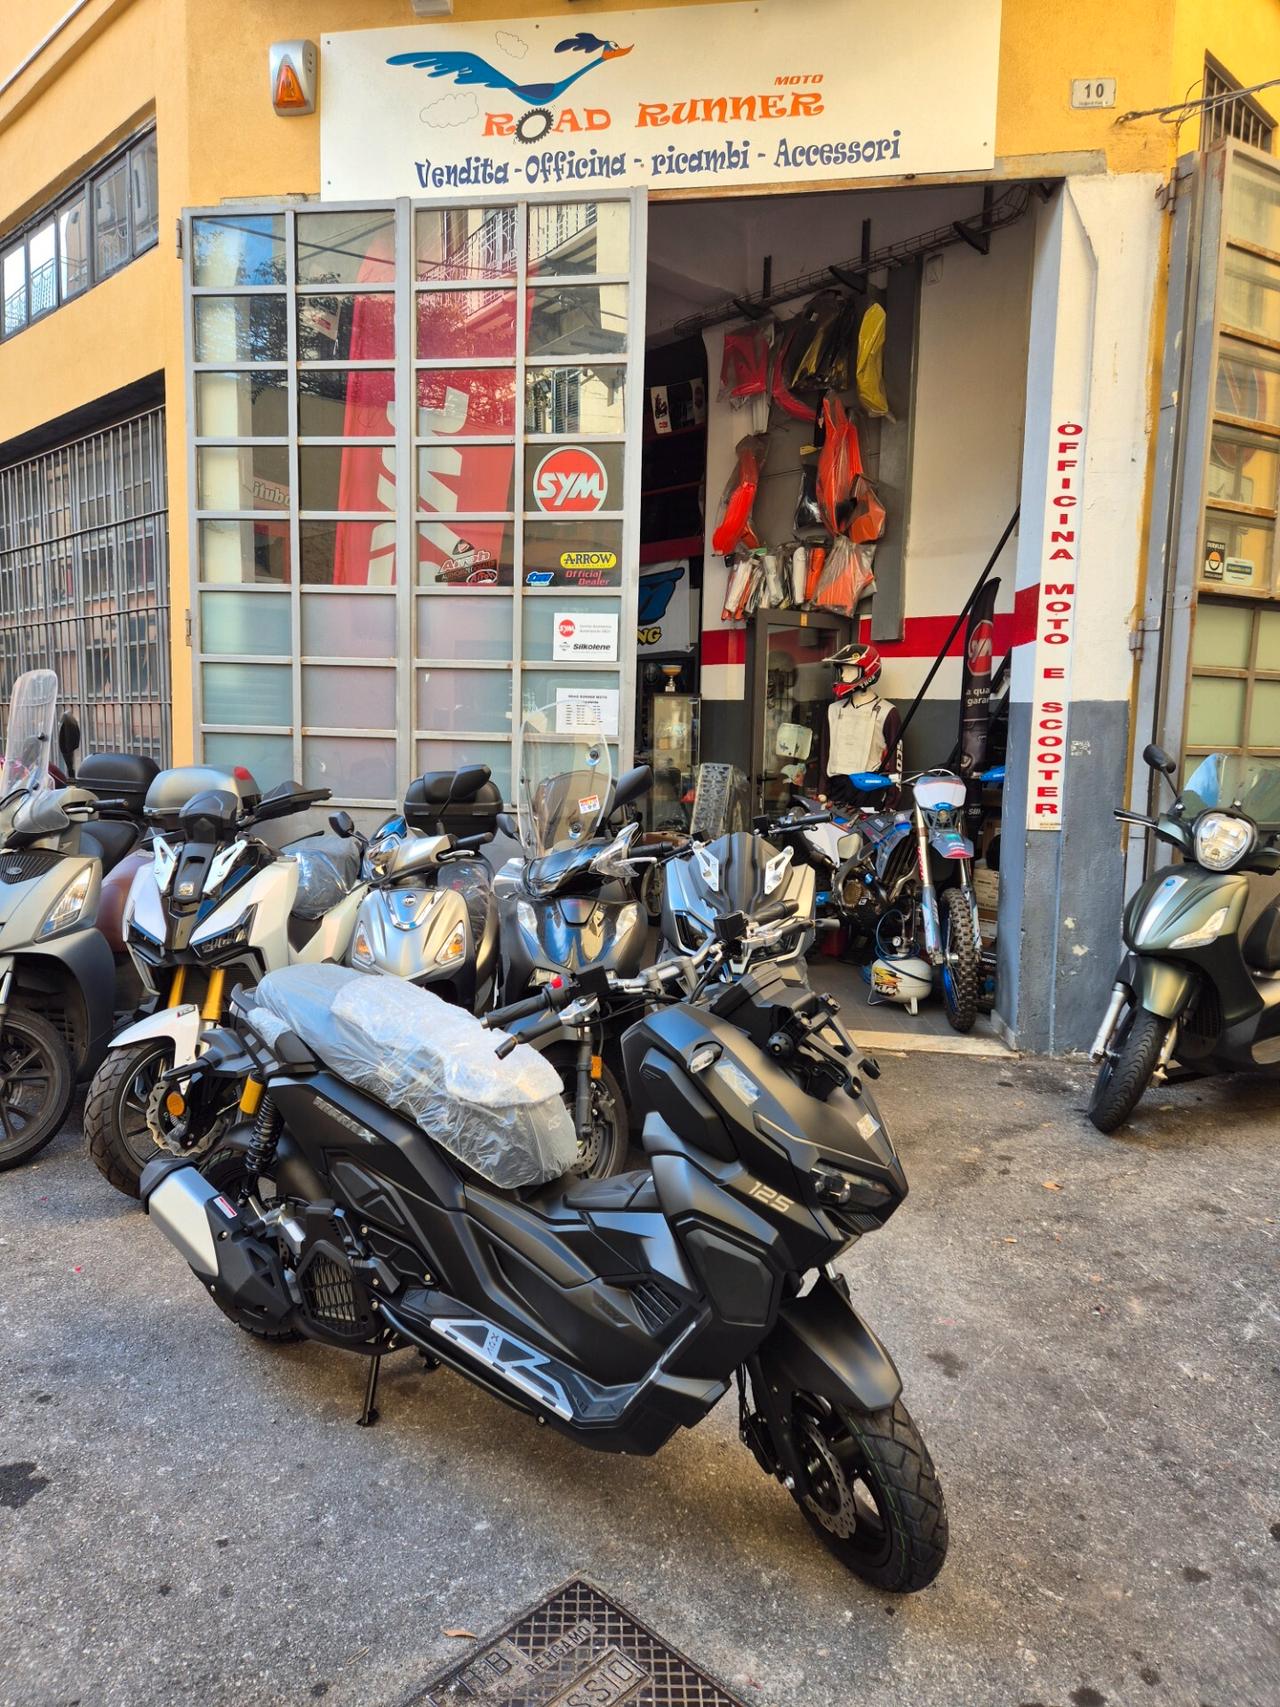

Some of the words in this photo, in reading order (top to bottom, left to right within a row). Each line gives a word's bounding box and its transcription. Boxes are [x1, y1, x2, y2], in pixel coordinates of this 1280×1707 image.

[774, 74, 824, 86] MOTO
[1084, 83, 1104, 98] 10
[482, 106, 611, 144] ROAD
[637, 91, 825, 127] RUNNER
[415, 156, 509, 188] Vendita
[525, 148, 627, 184] Officina
[651, 140, 750, 176] ricambi
[773, 129, 902, 167] Accessori
[537, 472, 606, 506] SYM
[1049, 421, 1083, 560] OFFICINA
[564, 553, 613, 565] ARROW
[565, 570, 602, 578] Official
[578, 578, 610, 586] Dealer
[1044, 583, 1075, 645] MOTO
[1043, 668, 1065, 679] E
[1035, 701, 1064, 816] SCOOTER
[749, 1181, 795, 1213] 125
[525, 1624, 590, 1676] BERGAMO
